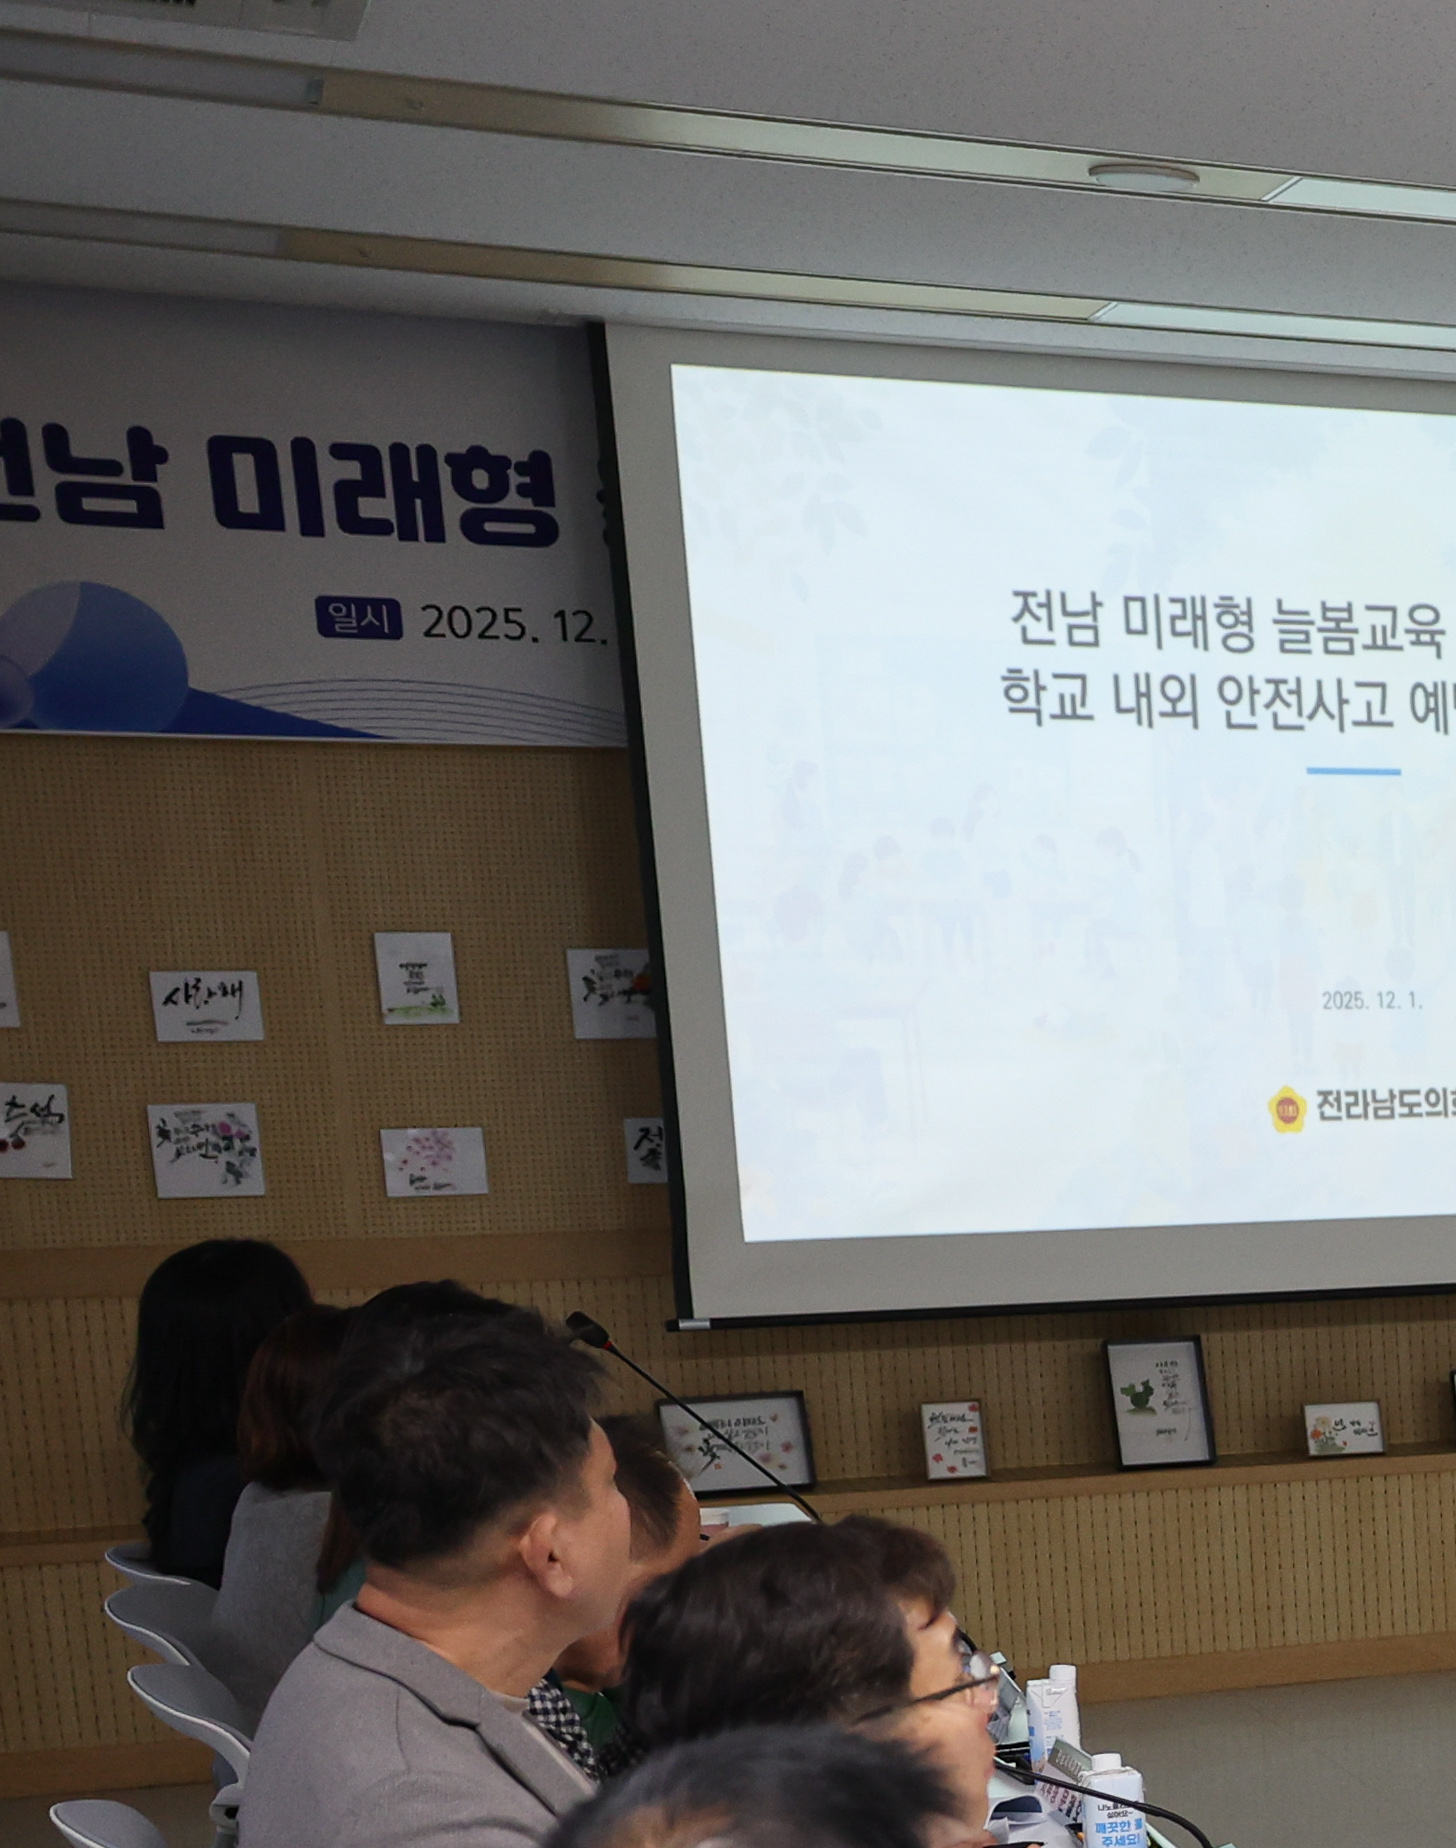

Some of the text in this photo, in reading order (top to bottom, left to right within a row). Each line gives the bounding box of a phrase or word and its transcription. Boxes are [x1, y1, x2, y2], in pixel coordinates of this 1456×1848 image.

[206, 434, 561, 549] 미래형
[328, 602, 390, 634] 일시
[421, 604, 541, 645] 2025.
[1010, 586, 1105, 651] 전남
[1122, 591, 1257, 655] 미래형
[1271, 597, 1448, 660] 늘봄교육
[1000, 666, 1096, 728] 학교
[1112, 670, 1201, 731] 내외
[1216, 673, 1395, 735] 안전사고
[1322, 990, 1423, 1011] 2025. 12. 1.
[1096, 1820, 1131, 1834] 깨끗한
[1101, 1833, 1141, 1848] 주세요!
